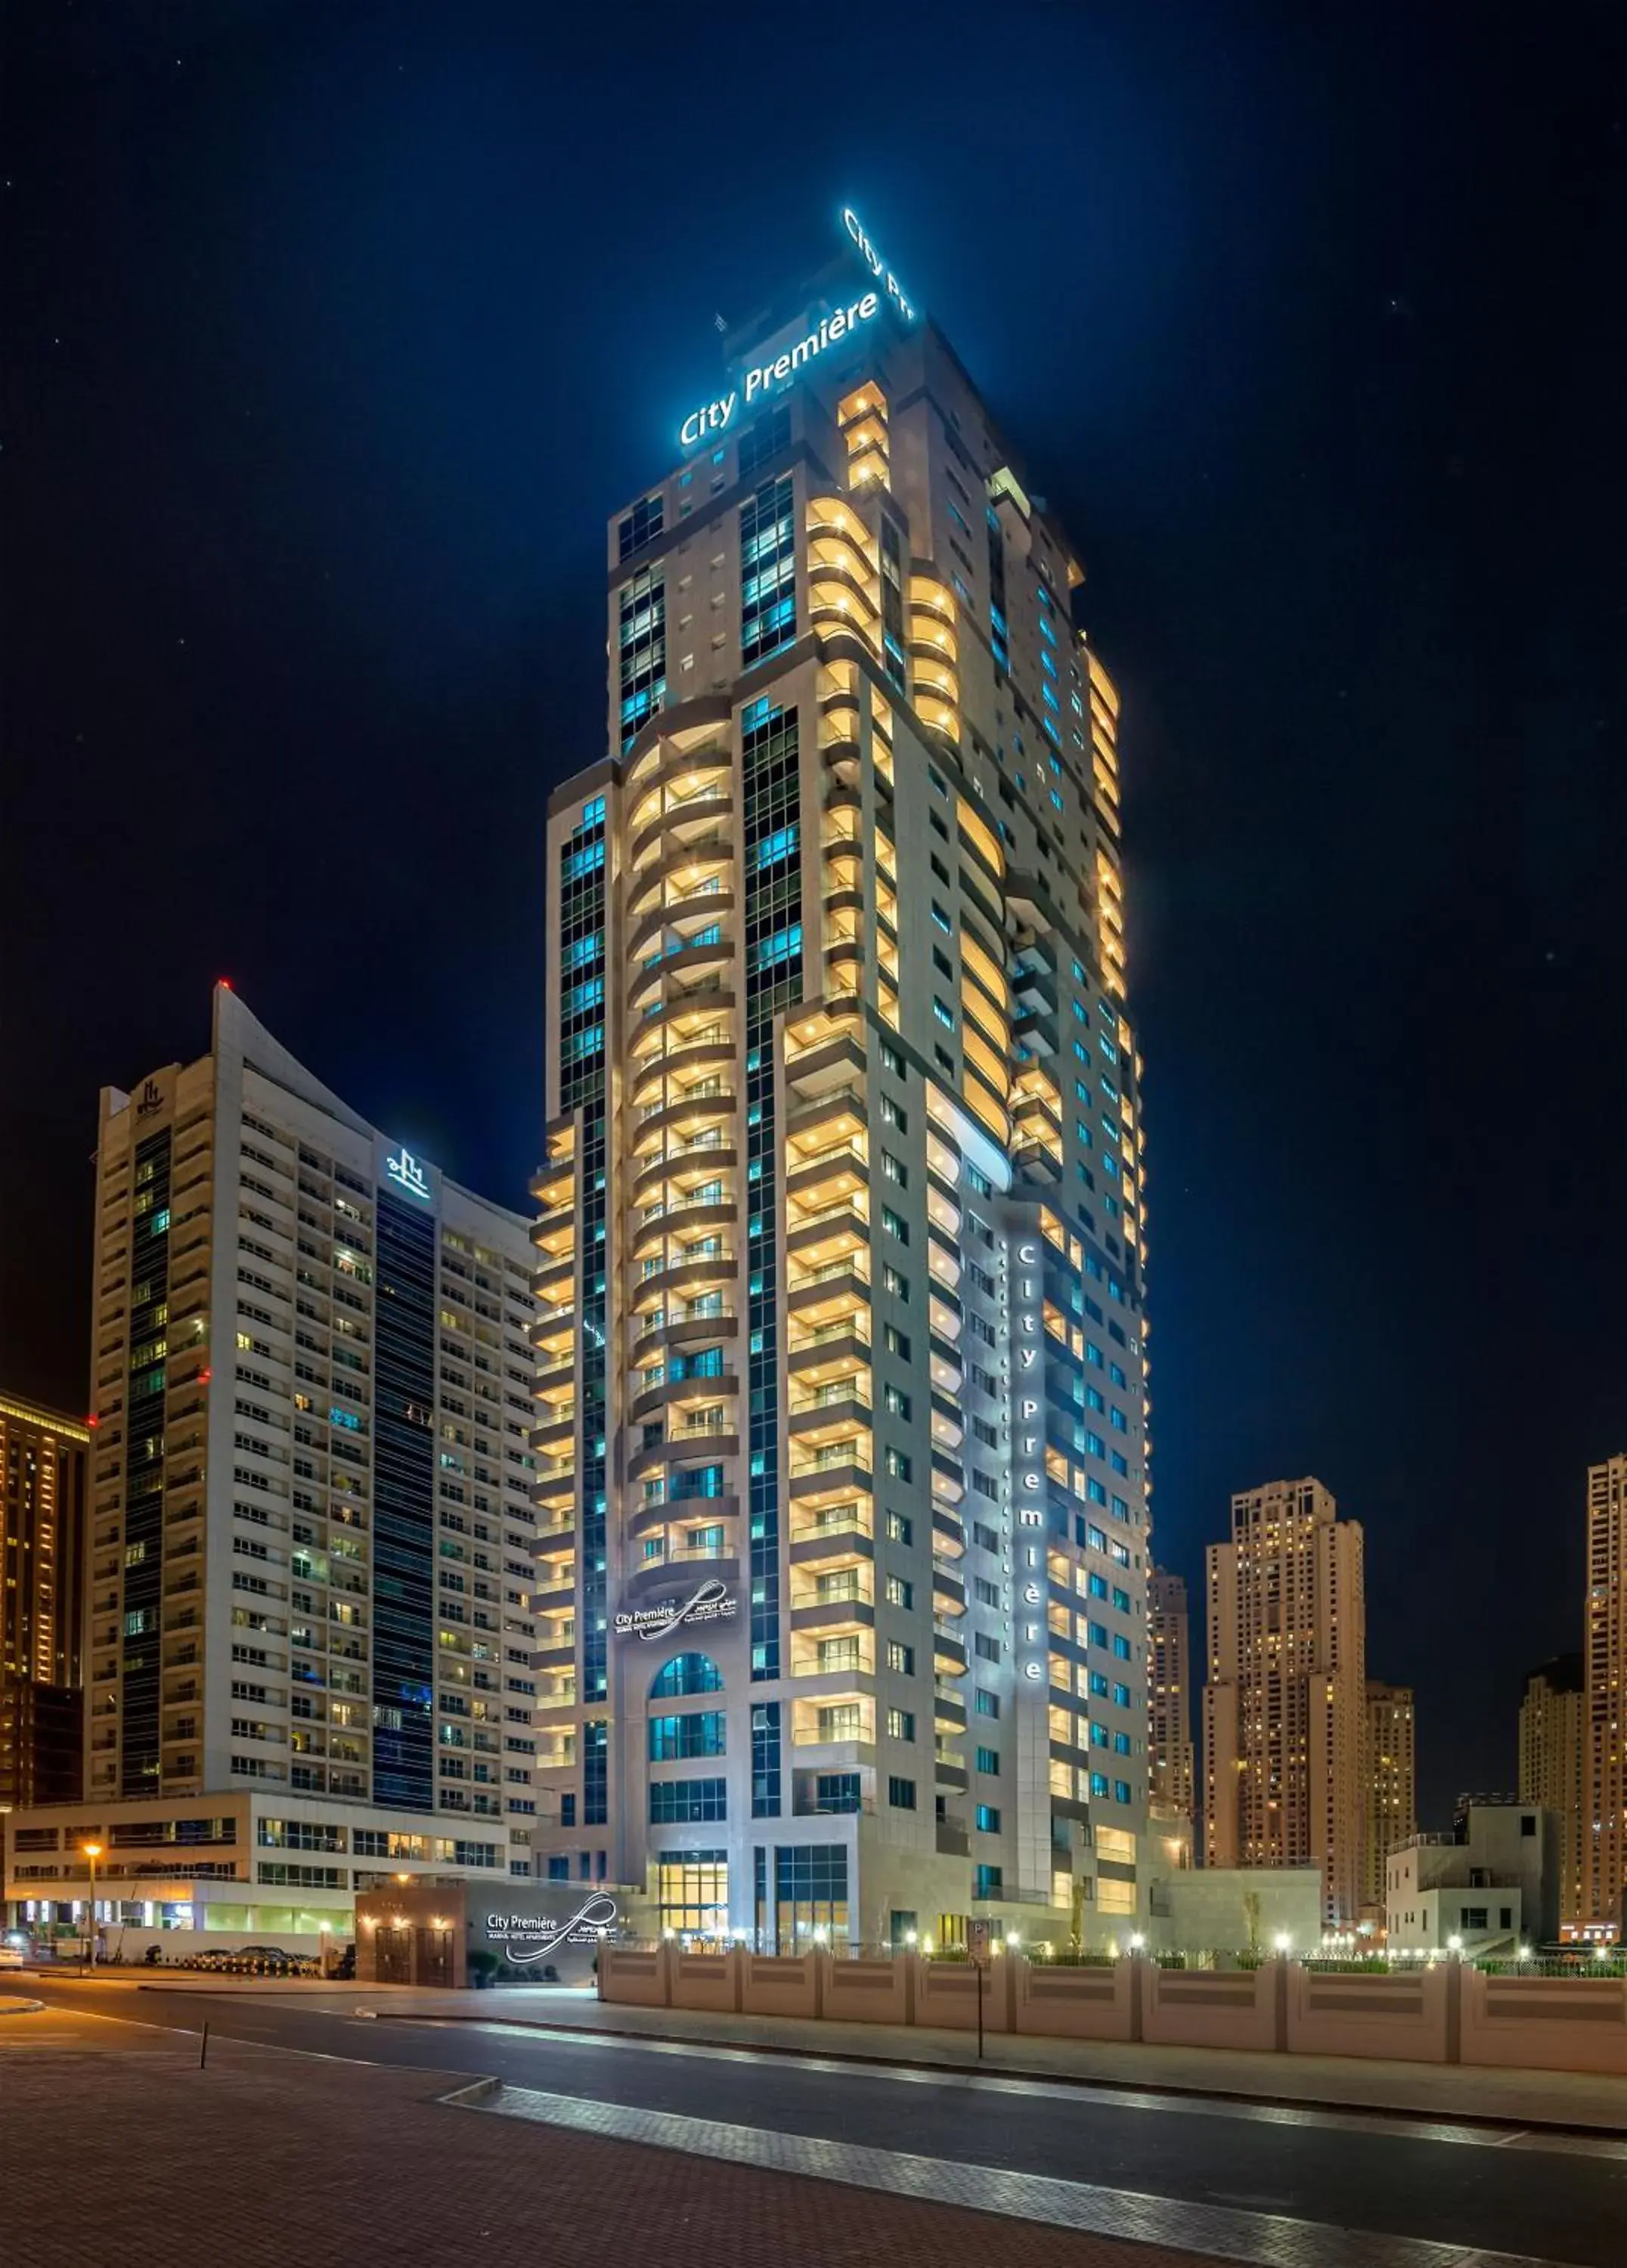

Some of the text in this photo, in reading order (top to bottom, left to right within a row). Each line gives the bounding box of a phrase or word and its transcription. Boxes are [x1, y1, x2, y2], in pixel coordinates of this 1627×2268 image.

[680, 292, 878, 445] City Première
[1018, 1244, 1042, 1683] City Première
[488, 1914, 509, 1930] City
